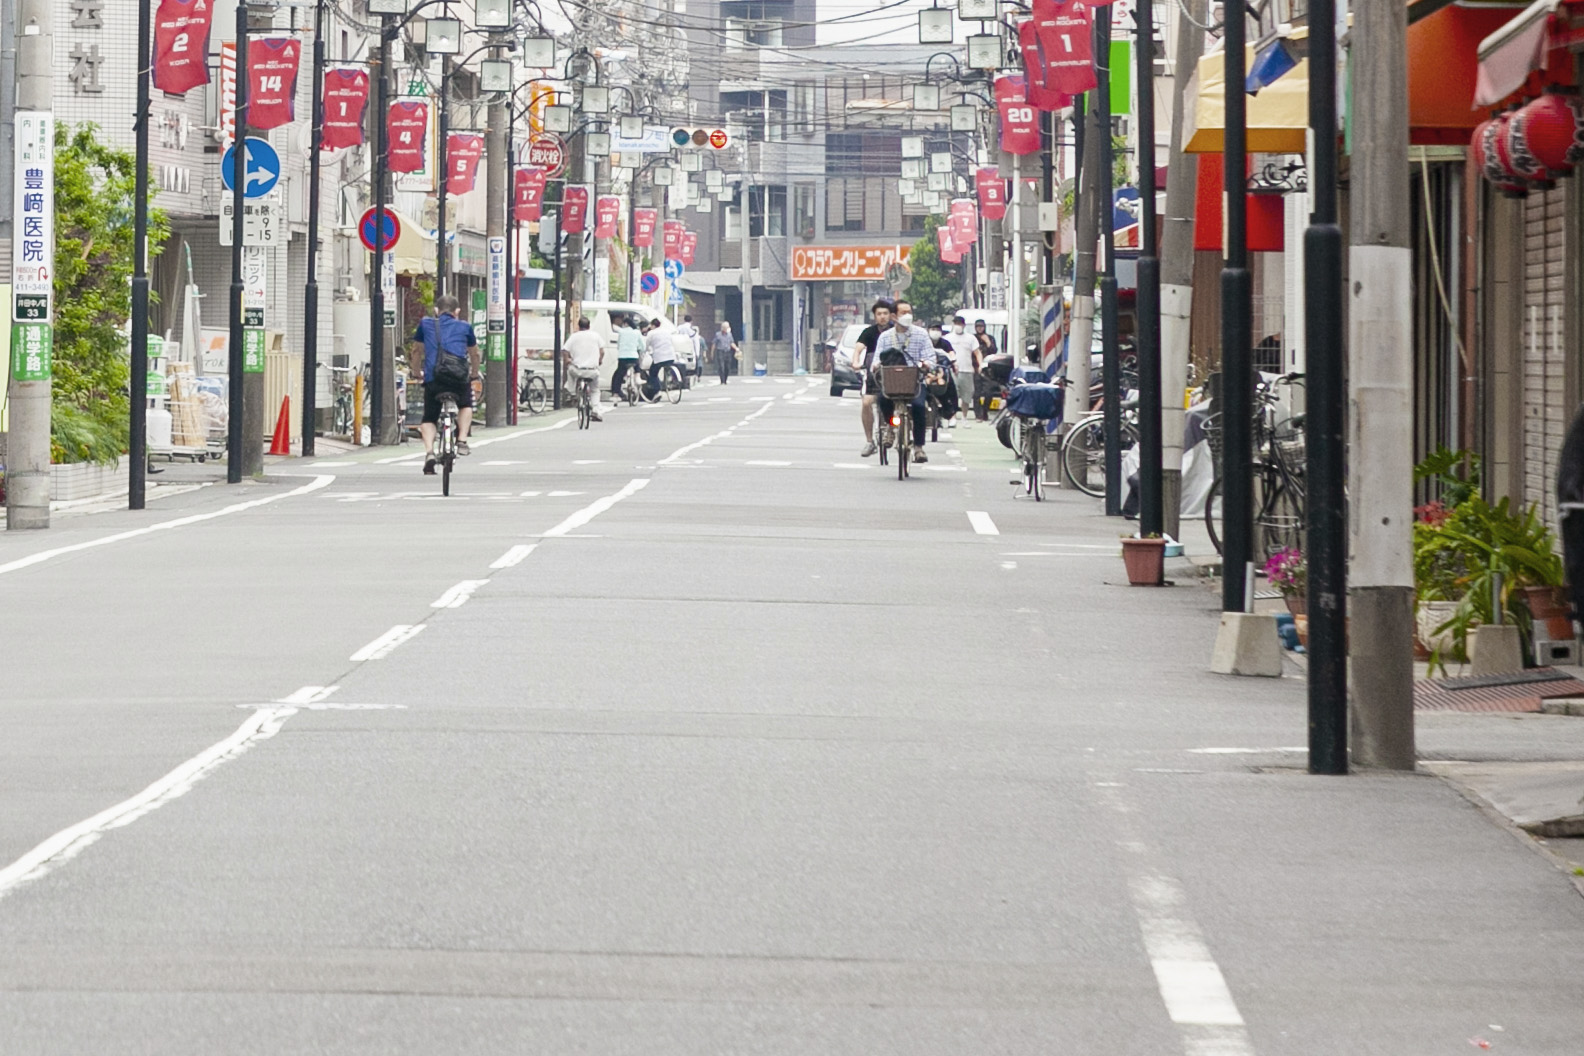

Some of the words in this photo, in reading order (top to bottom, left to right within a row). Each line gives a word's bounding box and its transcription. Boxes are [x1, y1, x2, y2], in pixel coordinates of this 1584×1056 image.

[172, 32, 189, 52] 2
[1061, 34, 1072, 53] 1
[260, 75, 282, 93] 14
[339, 101, 347, 116] 1
[1008, 108, 1033, 123] 20
[400, 131, 411, 144] 4
[531, 149, 559, 164] 消火栓
[456, 159, 467, 172] 5
[522, 190, 536, 201] 17
[988, 189, 997, 199] 3
[224, 205, 276, 216] 自車を除く
[570, 206, 578, 215] 2
[27, 309, 38, 317] 33
[26, 326, 41, 371] 通学路
[246, 331, 258, 366] 通学路
